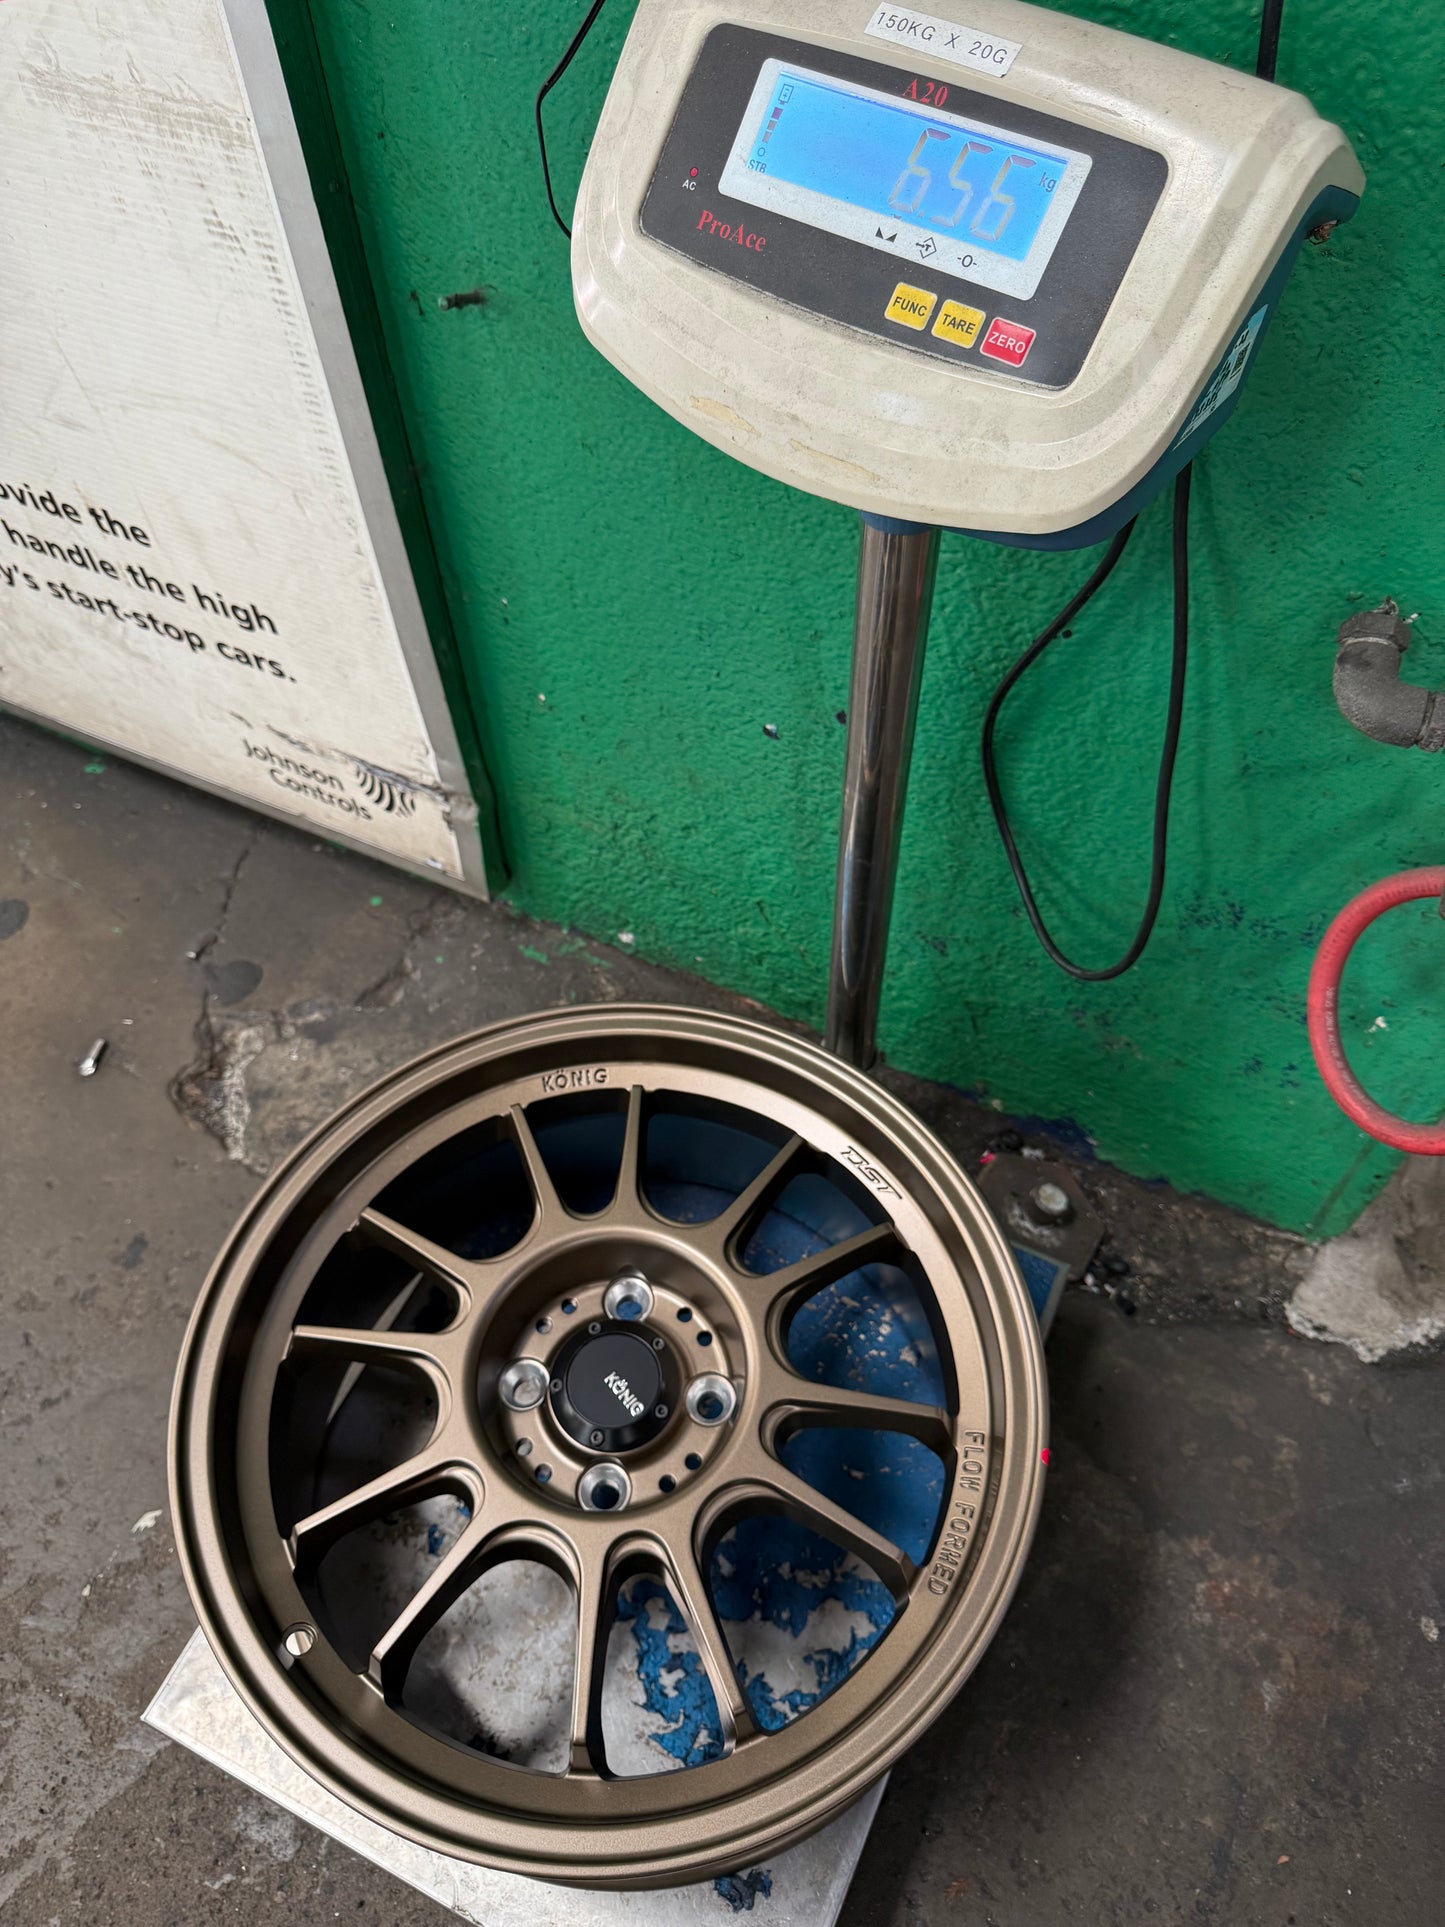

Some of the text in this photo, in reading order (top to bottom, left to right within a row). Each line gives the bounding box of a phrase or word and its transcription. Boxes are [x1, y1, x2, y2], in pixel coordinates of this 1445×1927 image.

[876, 11, 1009, 65] 150KG X 20G
[901, 78, 949, 108] A20
[681, 178, 697, 192] AC
[747, 159, 768, 174] STB
[888, 127, 1058, 242] 6.56 kg
[695, 209, 768, 253] ProAce
[892, 295, 929, 318] FUNC
[941, 312, 977, 336] TARE
[986, 330, 1027, 355] ZERO
[87, 507, 152, 548] the
[1, 517, 280, 636] handle the high
[46, 580, 207, 652] start-stop
[215, 641, 298, 684] cars.
[241, 736, 346, 793] Johnson
[268, 767, 374, 822] Controls
[541, 1068, 608, 1093] KÖNIG
[603, 1370, 645, 1417] KÖNIG
[926, 1430, 986, 1596] FLOW FORMED
